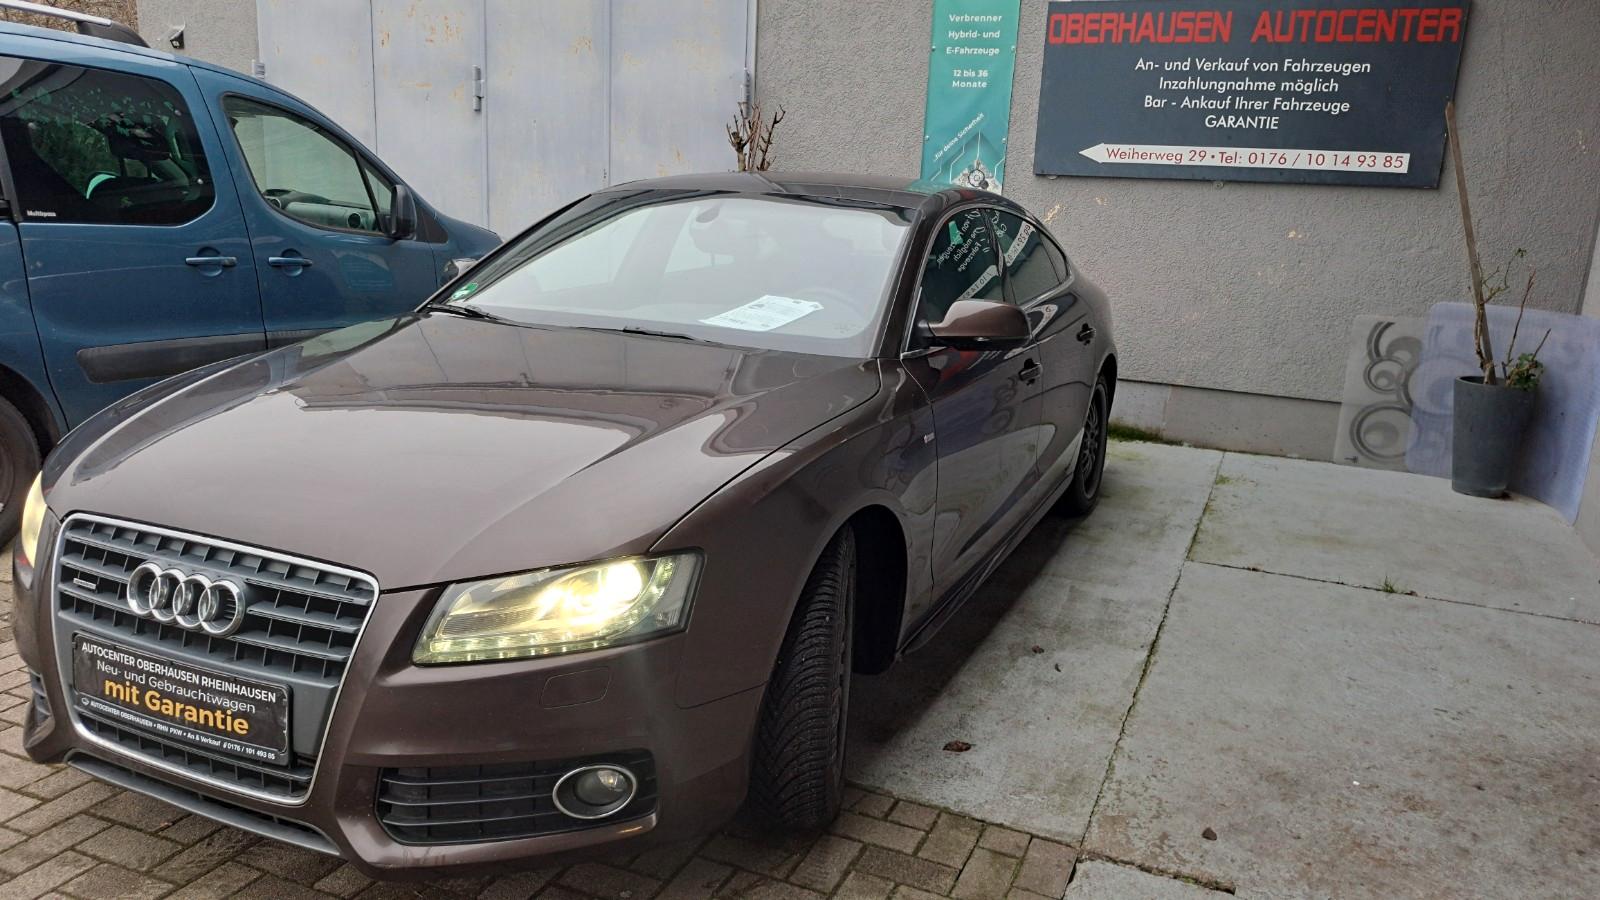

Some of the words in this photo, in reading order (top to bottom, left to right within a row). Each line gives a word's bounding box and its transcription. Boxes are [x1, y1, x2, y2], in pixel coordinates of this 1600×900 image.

[948, 14, 1002, 22] Verbrenner
[1048, 11, 1232, 44] OBERHAUSEN
[1251, 8, 1461, 42] AUTOCENTER
[948, 30, 980, 40] Hybrid-
[982, 30, 1001, 38] und
[946, 46, 1000, 56] E-Fahrzeuge
[953, 69, 961, 77] 12
[963, 69, 976, 77] bis
[977, 69, 988, 77] 36
[1135, 57, 1159, 71] An-
[1164, 58, 1190, 71] und
[1196, 58, 1250, 71] Verkauf
[1253, 62, 1278, 72] von
[1283, 59, 1371, 76] Fahrzeugen
[1159, 77, 1276, 93] Inzahlungnahme
[1280, 79, 1339, 95] möglich
[1144, 95, 1168, 108] Bar
[1180, 97, 1232, 109] Ankauf
[1234, 97, 1269, 110] Ihrer
[1273, 98, 1350, 114] Fahrzeuge
[1205, 115, 1280, 129] GARANTIE
[1106, 147, 1183, 164] Weiherweg
[1189, 149, 1207, 162] 29
[1218, 151, 1242, 164] Tel:
[1248, 152, 1287, 165] 0176
[1291, 153, 1300, 167] /
[1307, 153, 1325, 166] 10
[1333, 154, 1350, 167] 14
[1357, 154, 1377, 167] 93
[1383, 155, 1404, 168] 85
[81, 642, 136, 667] AUTOCENTER
[136, 658, 200, 685] OBERHAUSEN
[201, 676, 277, 703] RHEINHAUSEN
[96, 660, 122, 676] Neu-
[124, 670, 146, 684] und
[148, 676, 256, 714] Gebrauchtwagen
[90, 700, 121, 716] AUTOCENTER
[120, 711, 154, 728] OBERHAUSEN
[104, 679, 140, 705] mit
[144, 690, 249, 735] Garantie
